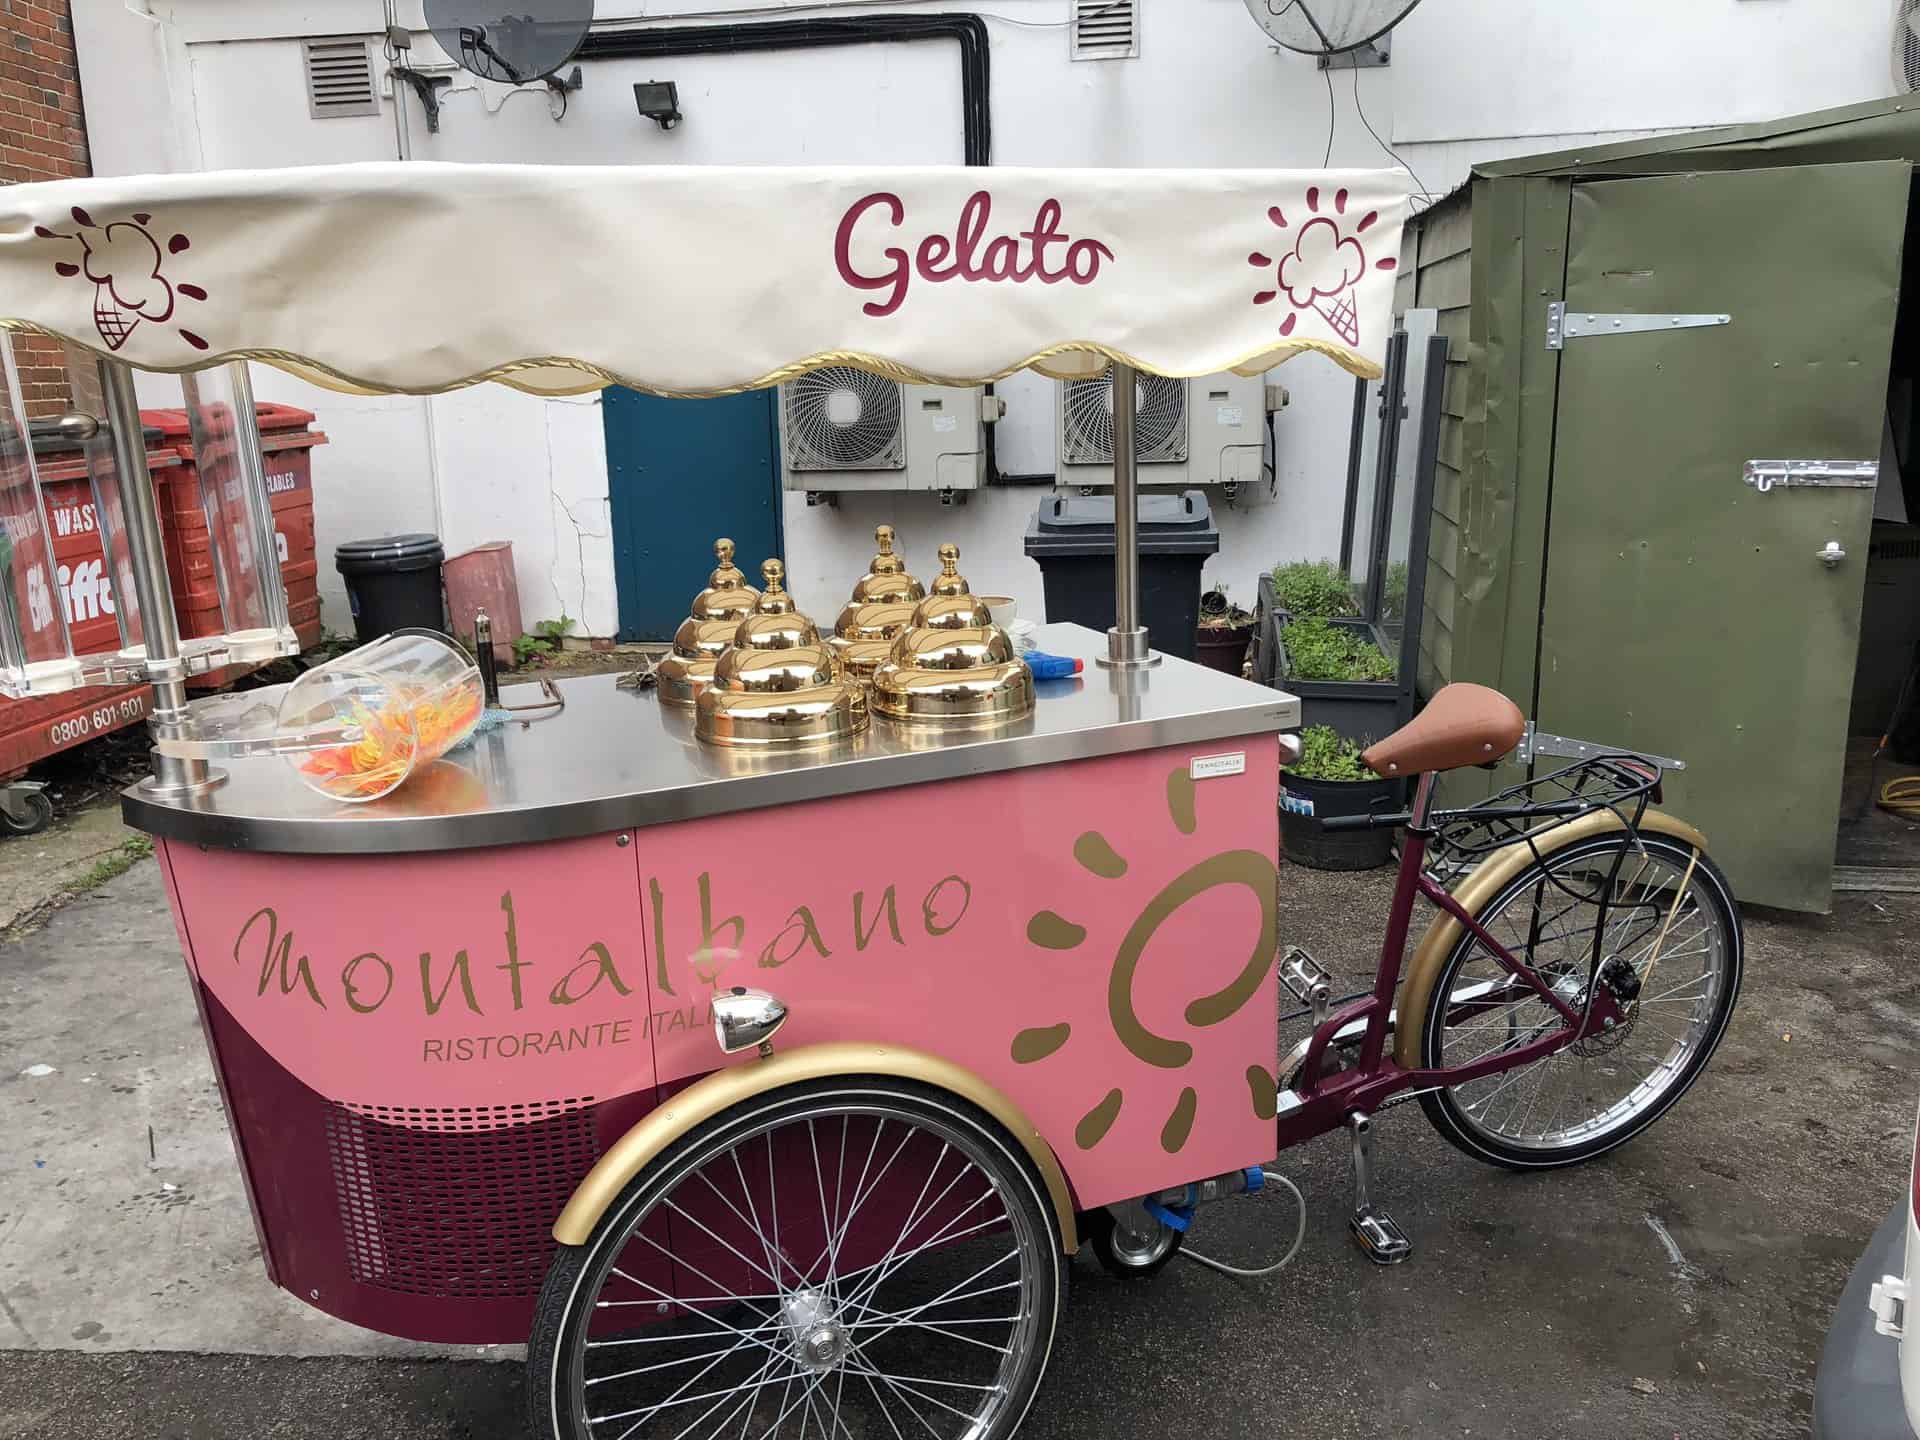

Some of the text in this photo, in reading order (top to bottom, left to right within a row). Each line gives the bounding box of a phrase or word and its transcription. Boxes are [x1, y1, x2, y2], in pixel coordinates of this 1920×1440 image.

[834, 190, 1114, 317] Gelato
[54, 502, 100, 537] WAS
[423, 1002, 718, 1062] RISTORANTE ITALI
